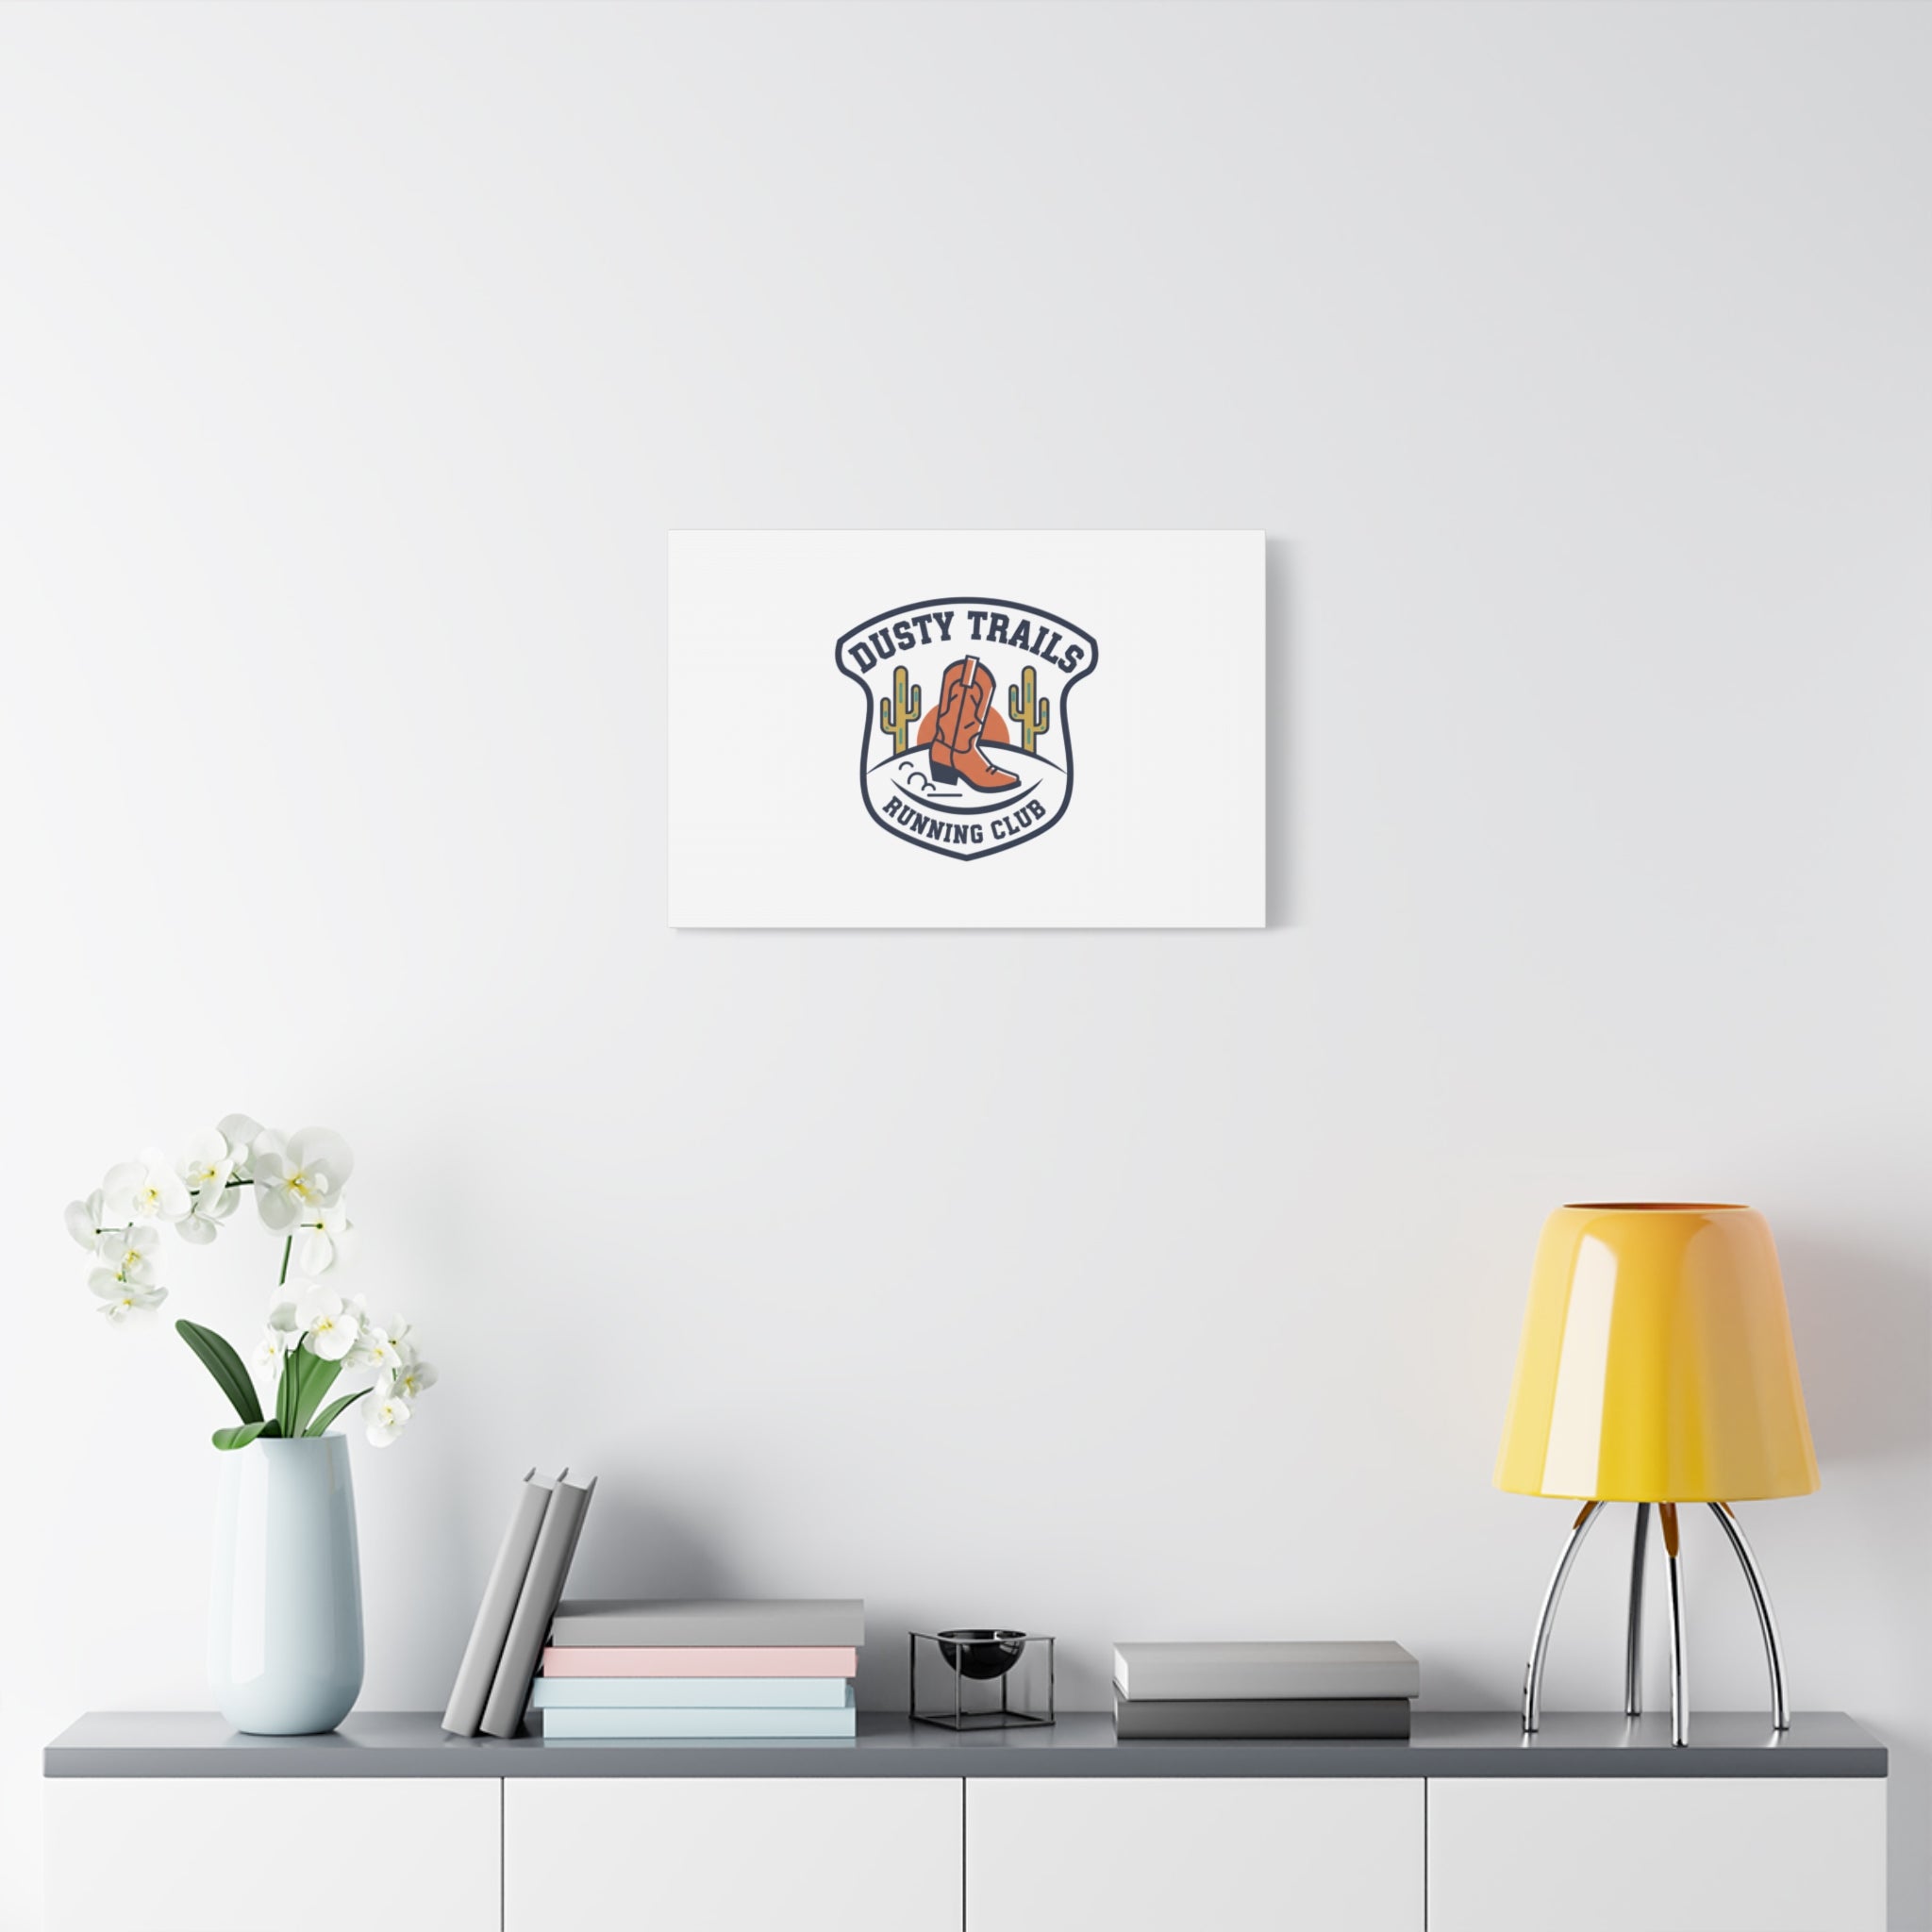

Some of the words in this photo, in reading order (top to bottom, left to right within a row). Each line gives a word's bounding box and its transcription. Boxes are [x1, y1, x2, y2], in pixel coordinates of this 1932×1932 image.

[847, 610, 955, 675] DUSTY
[967, 610, 1085, 674] TRAILS
[882, 795, 984, 844] RUNNING
[991, 799, 1046, 841] CLUB
